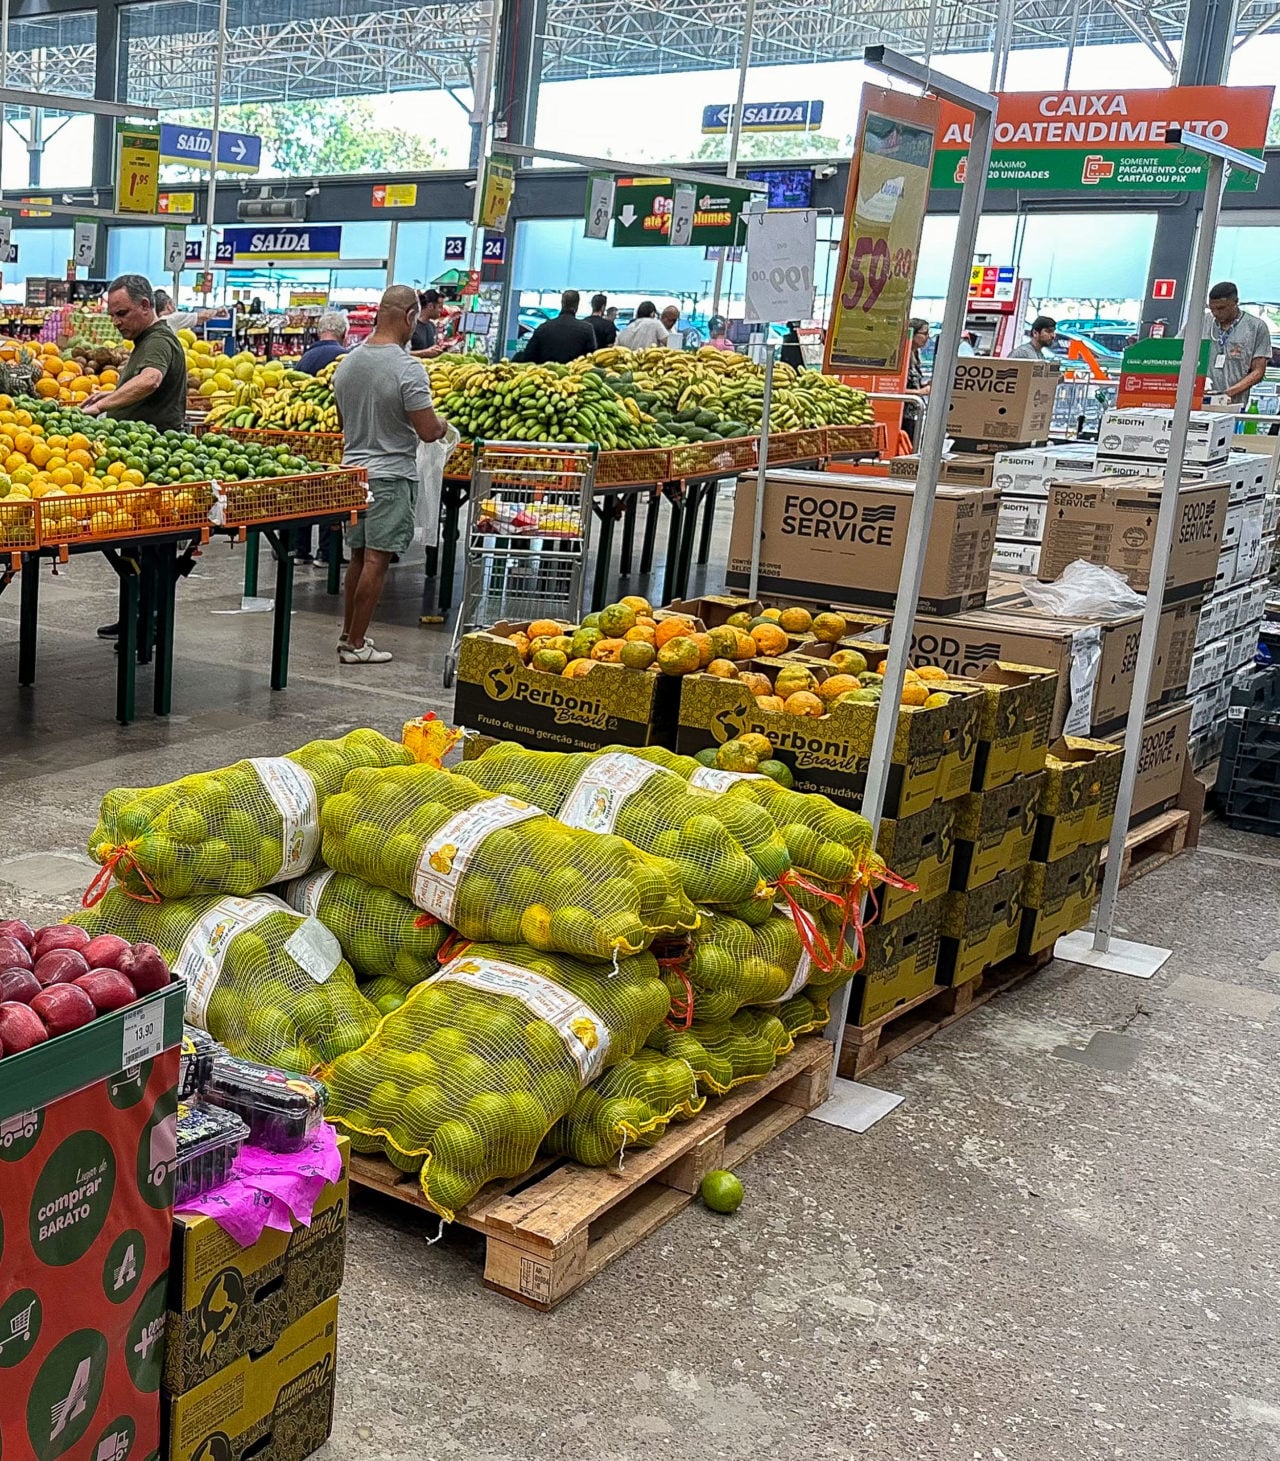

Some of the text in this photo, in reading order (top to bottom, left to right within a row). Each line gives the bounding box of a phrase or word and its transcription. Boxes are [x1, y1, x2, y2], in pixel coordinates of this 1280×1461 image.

[743, 104, 803, 124] SAÍDA
[1039, 95, 1128, 116] CAIXA
[176, 132, 214, 153] SAÍD
[990, 160, 1027, 168] MÁXIMO
[1119, 166, 1174, 174] PAGAMENTO
[1120, 158, 1159, 166] SOMENTE
[988, 170, 1050, 179] 20 UNIDADES
[1117, 173, 1153, 183] CARTÃO
[1171, 175, 1186, 183] PIX
[217, 243, 232, 258] 22
[250, 230, 310, 252] SAÍDA
[447, 241, 462, 254] 23
[485, 242, 501, 255] 24
[955, 366, 993, 379] OOD
[953, 378, 1016, 394] ERVICE
[1054, 498, 1096, 509] SERVICE
[1055, 491, 1083, 500] FOOD
[785, 495, 858, 521] FOOD
[1182, 503, 1205, 524] FOOD
[781, 516, 893, 546] SERVICE
[1179, 521, 1214, 544] SERVICE
[516, 682, 601, 715] Perboni
[556, 707, 607, 730] Brasil
[477, 714, 573, 746] Fruto de uma geração
[799, 751, 857, 774] Brasil
[1137, 747, 1173, 774] SERVICE
[819, 784, 864, 801] saudáve
[76, 1158, 108, 1185] Lugar de
[38, 1178, 103, 1222] comprar
[39, 1203, 90, 1242] BARATO
